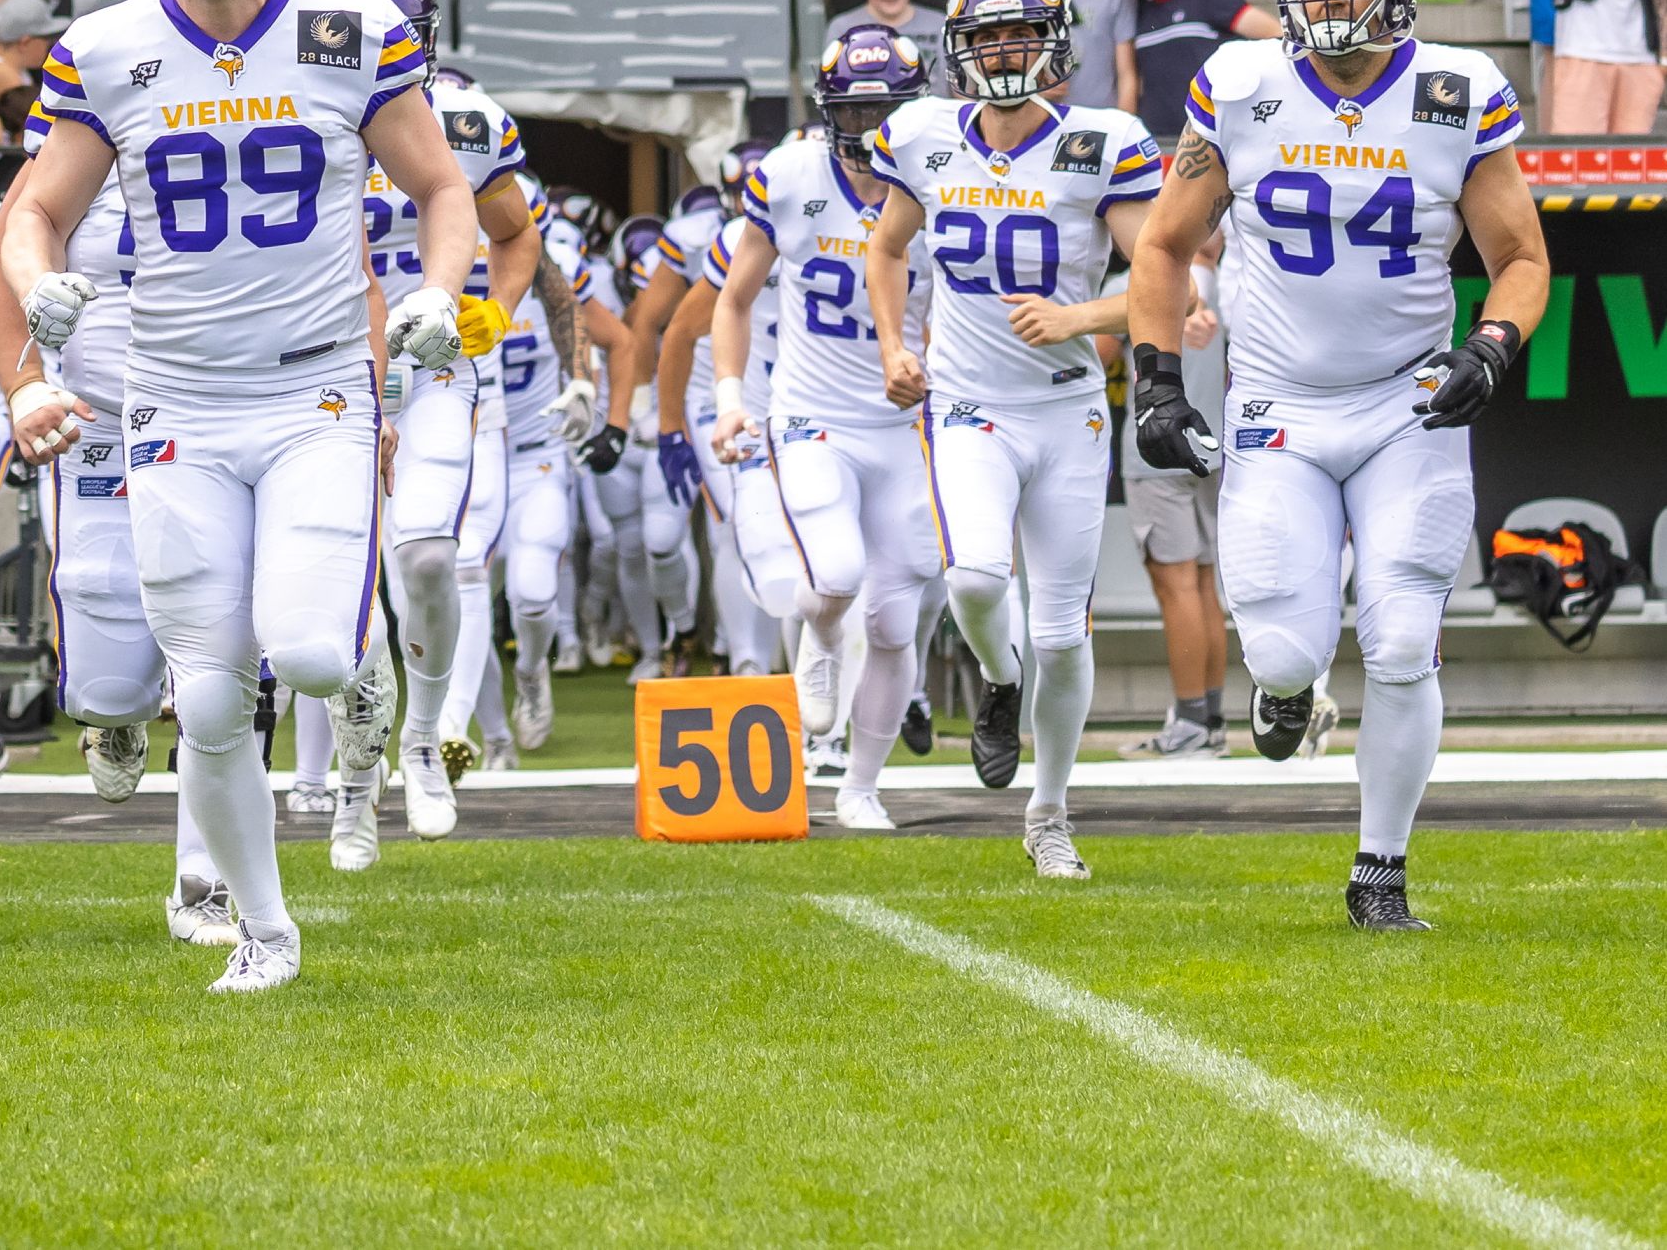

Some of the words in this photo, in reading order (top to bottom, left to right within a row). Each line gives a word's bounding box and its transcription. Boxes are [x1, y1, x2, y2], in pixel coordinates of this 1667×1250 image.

[300, 52, 317, 63] 28
[320, 52, 359, 68] BLACK
[849, 47, 890, 66] Chio
[160, 95, 299, 129] VIENNA
[1414, 110, 1429, 122] 28
[1431, 112, 1466, 128] BLACK
[461, 141, 489, 153] BLACK
[1279, 144, 1409, 171] VIENNA
[1052, 162, 1066, 172] 28
[1067, 163, 1100, 174] BLACK
[144, 124, 327, 253] 89
[939, 186, 1048, 209] VIENNA
[1254, 170, 1423, 279] 94
[816, 235, 870, 257] VIEN
[934, 211, 1060, 298] 20
[658, 704, 792, 817] 50
